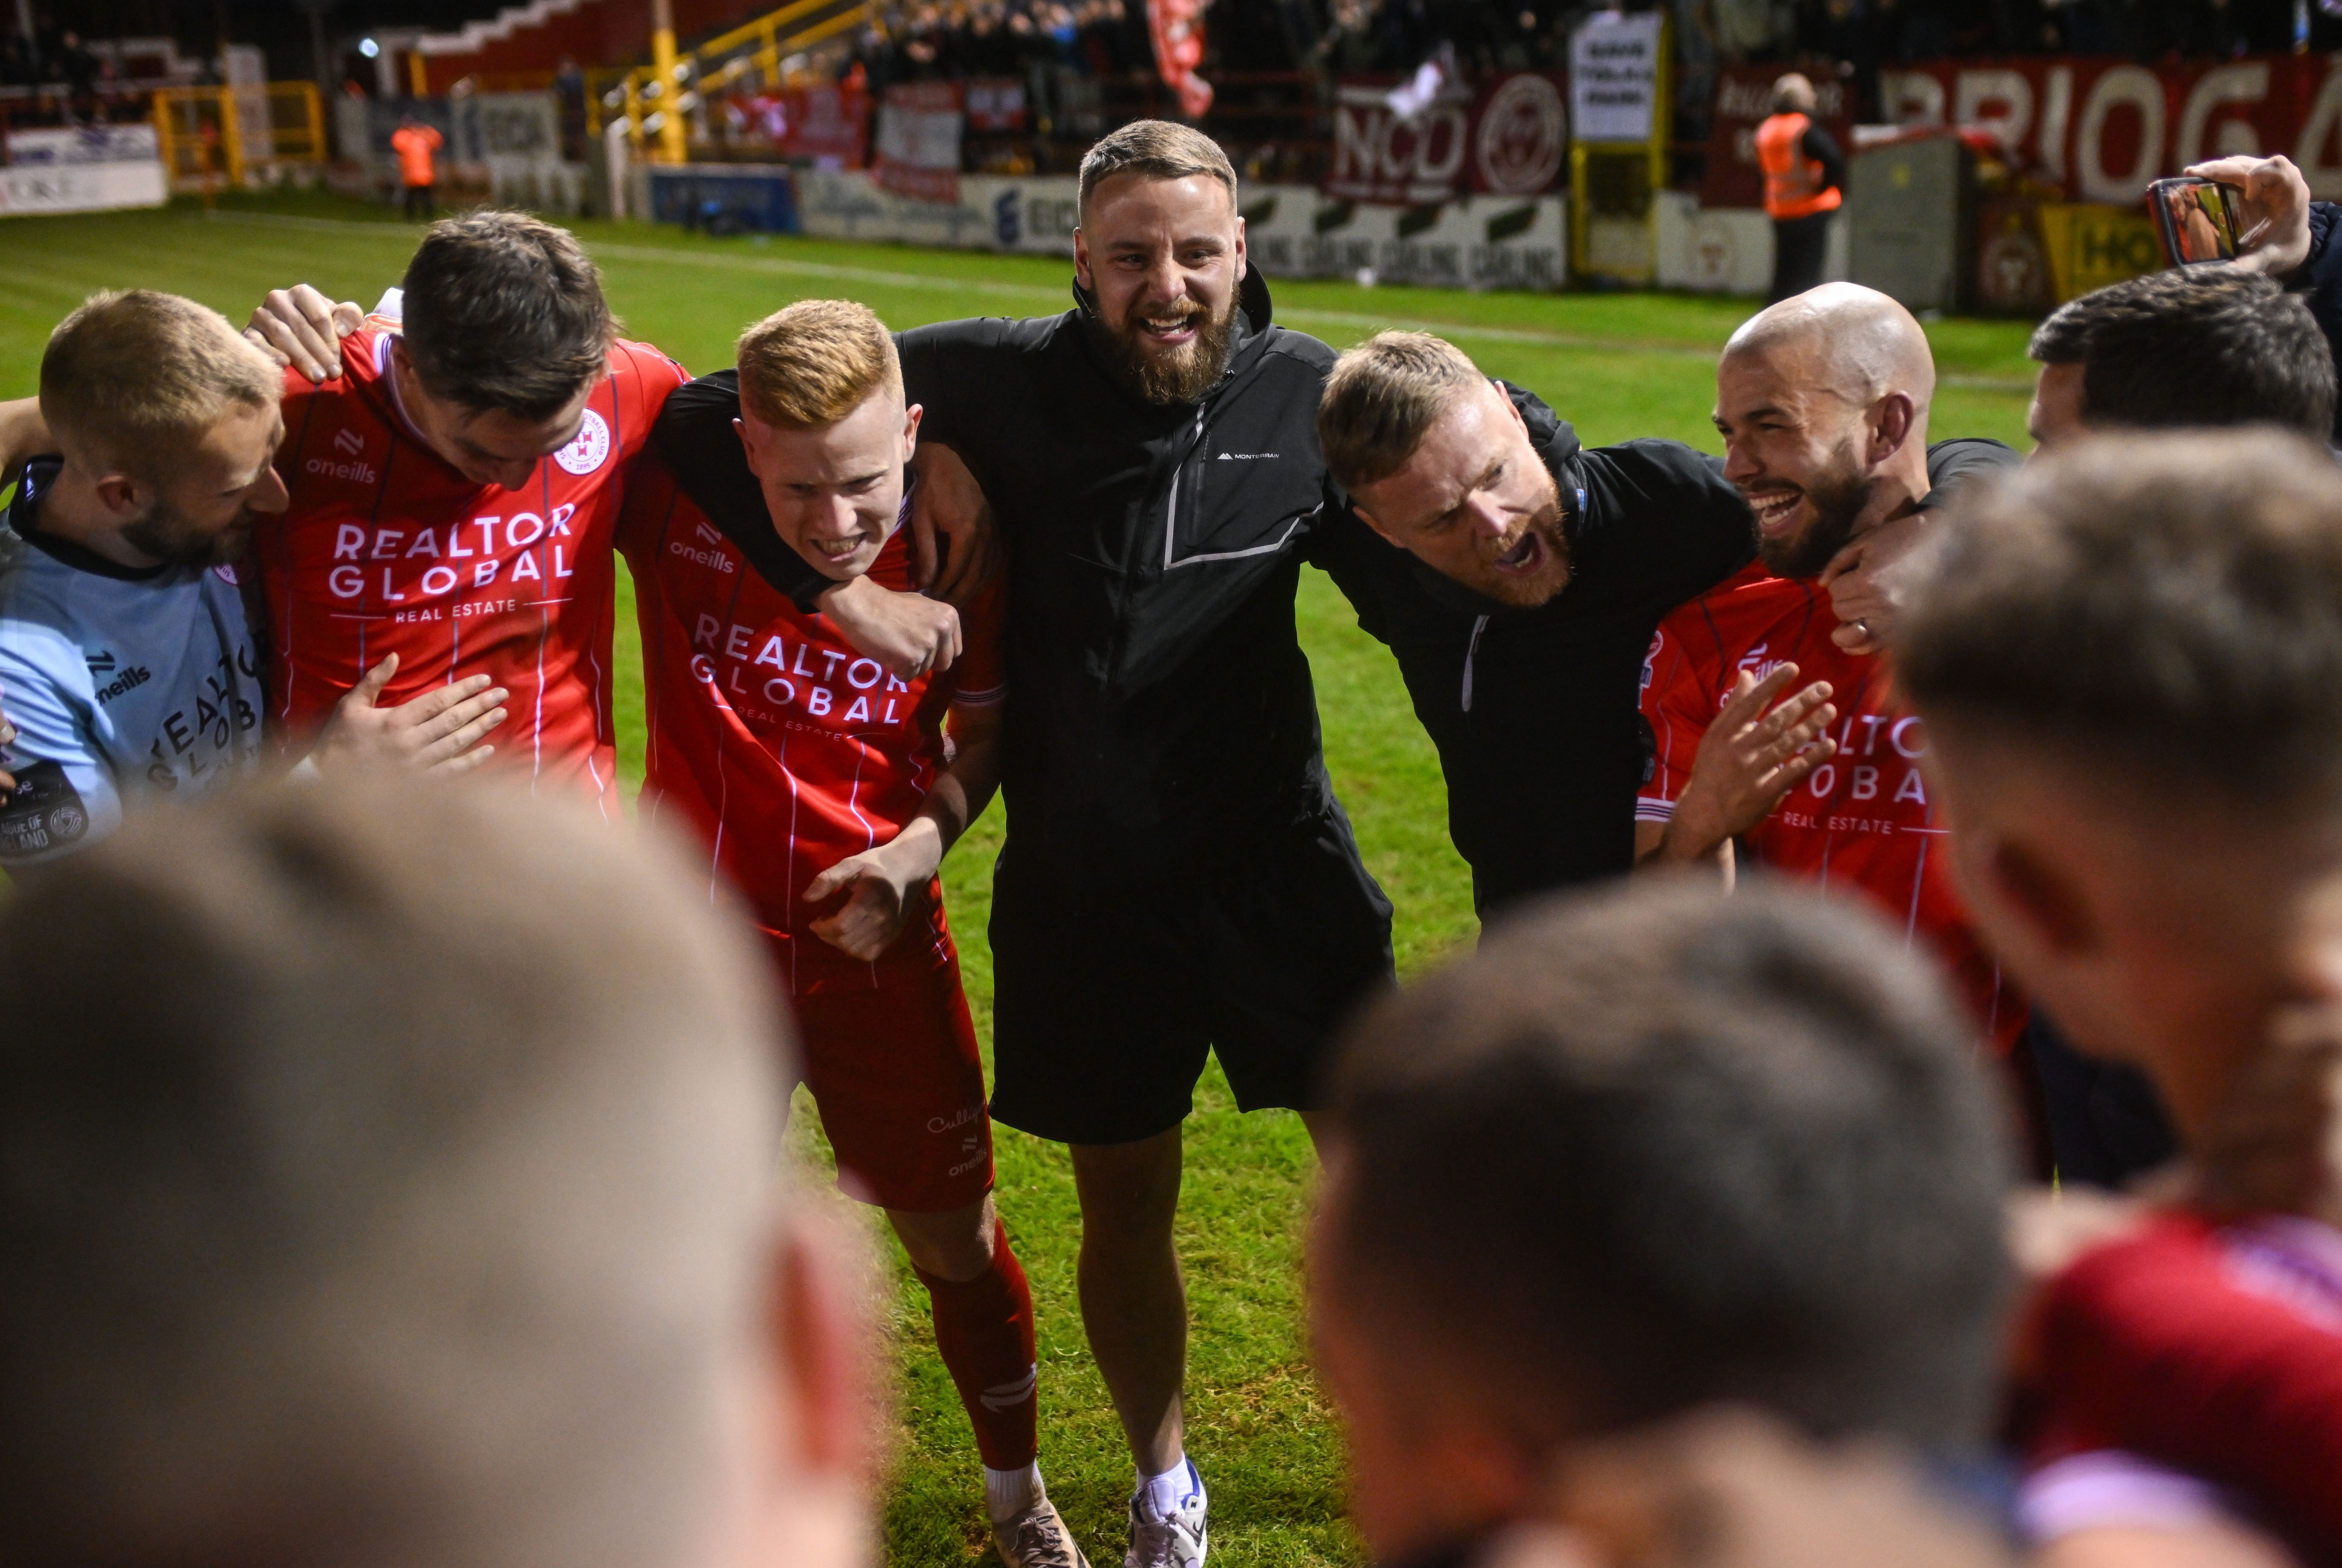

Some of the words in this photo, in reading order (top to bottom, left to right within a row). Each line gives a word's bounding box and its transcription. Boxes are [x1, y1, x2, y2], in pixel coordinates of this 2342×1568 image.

[584, 413, 603, 433] OTBALL
[333, 503, 576, 560] REALTOR
[329, 545, 574, 600] GLOBAL
[395, 609, 442, 623] REAL
[452, 599, 516, 618] ESTATE
[690, 653, 900, 724] GLOBAL
[738, 705, 777, 725] REAL
[785, 720, 843, 742] ESTATE
[1783, 811, 1818, 829] REAL
[1829, 816, 1893, 835] ESTATE
